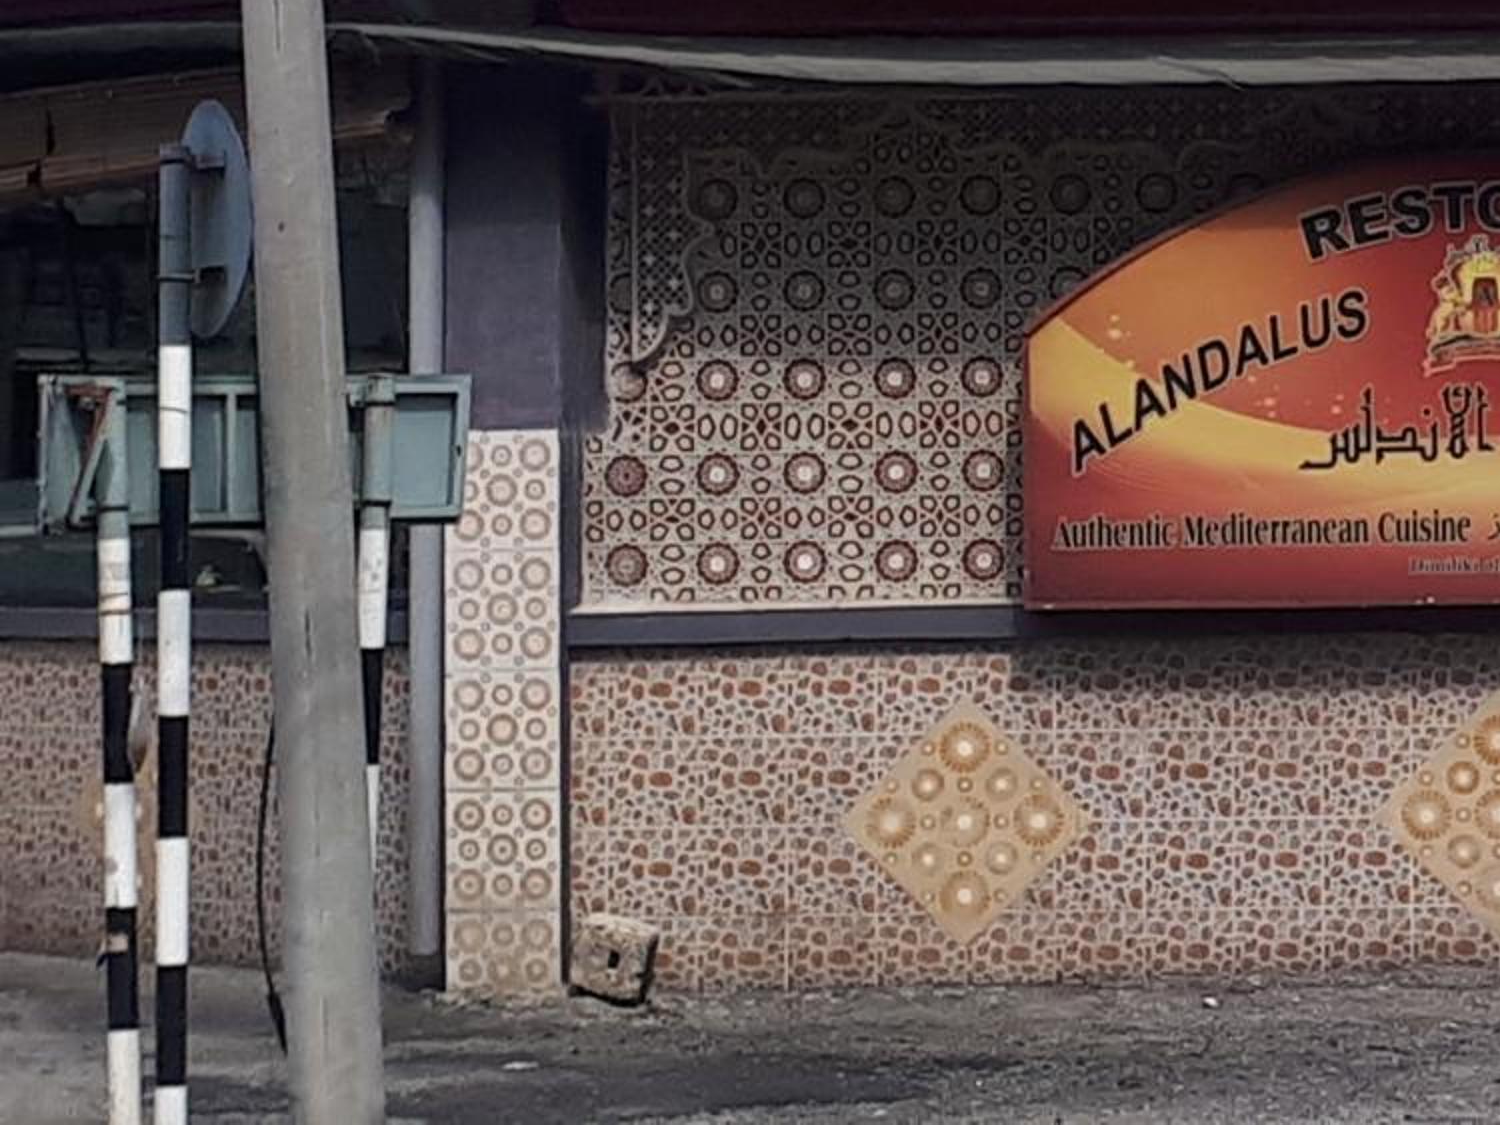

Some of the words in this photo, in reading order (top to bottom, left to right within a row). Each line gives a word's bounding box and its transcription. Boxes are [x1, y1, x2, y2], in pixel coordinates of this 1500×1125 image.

[1073, 291, 1367, 472] ALANDALUS
[1054, 512, 1177, 549] Authentic
[1183, 511, 1370, 547] Mediterranean
[1378, 508, 1472, 544] Cuisine
